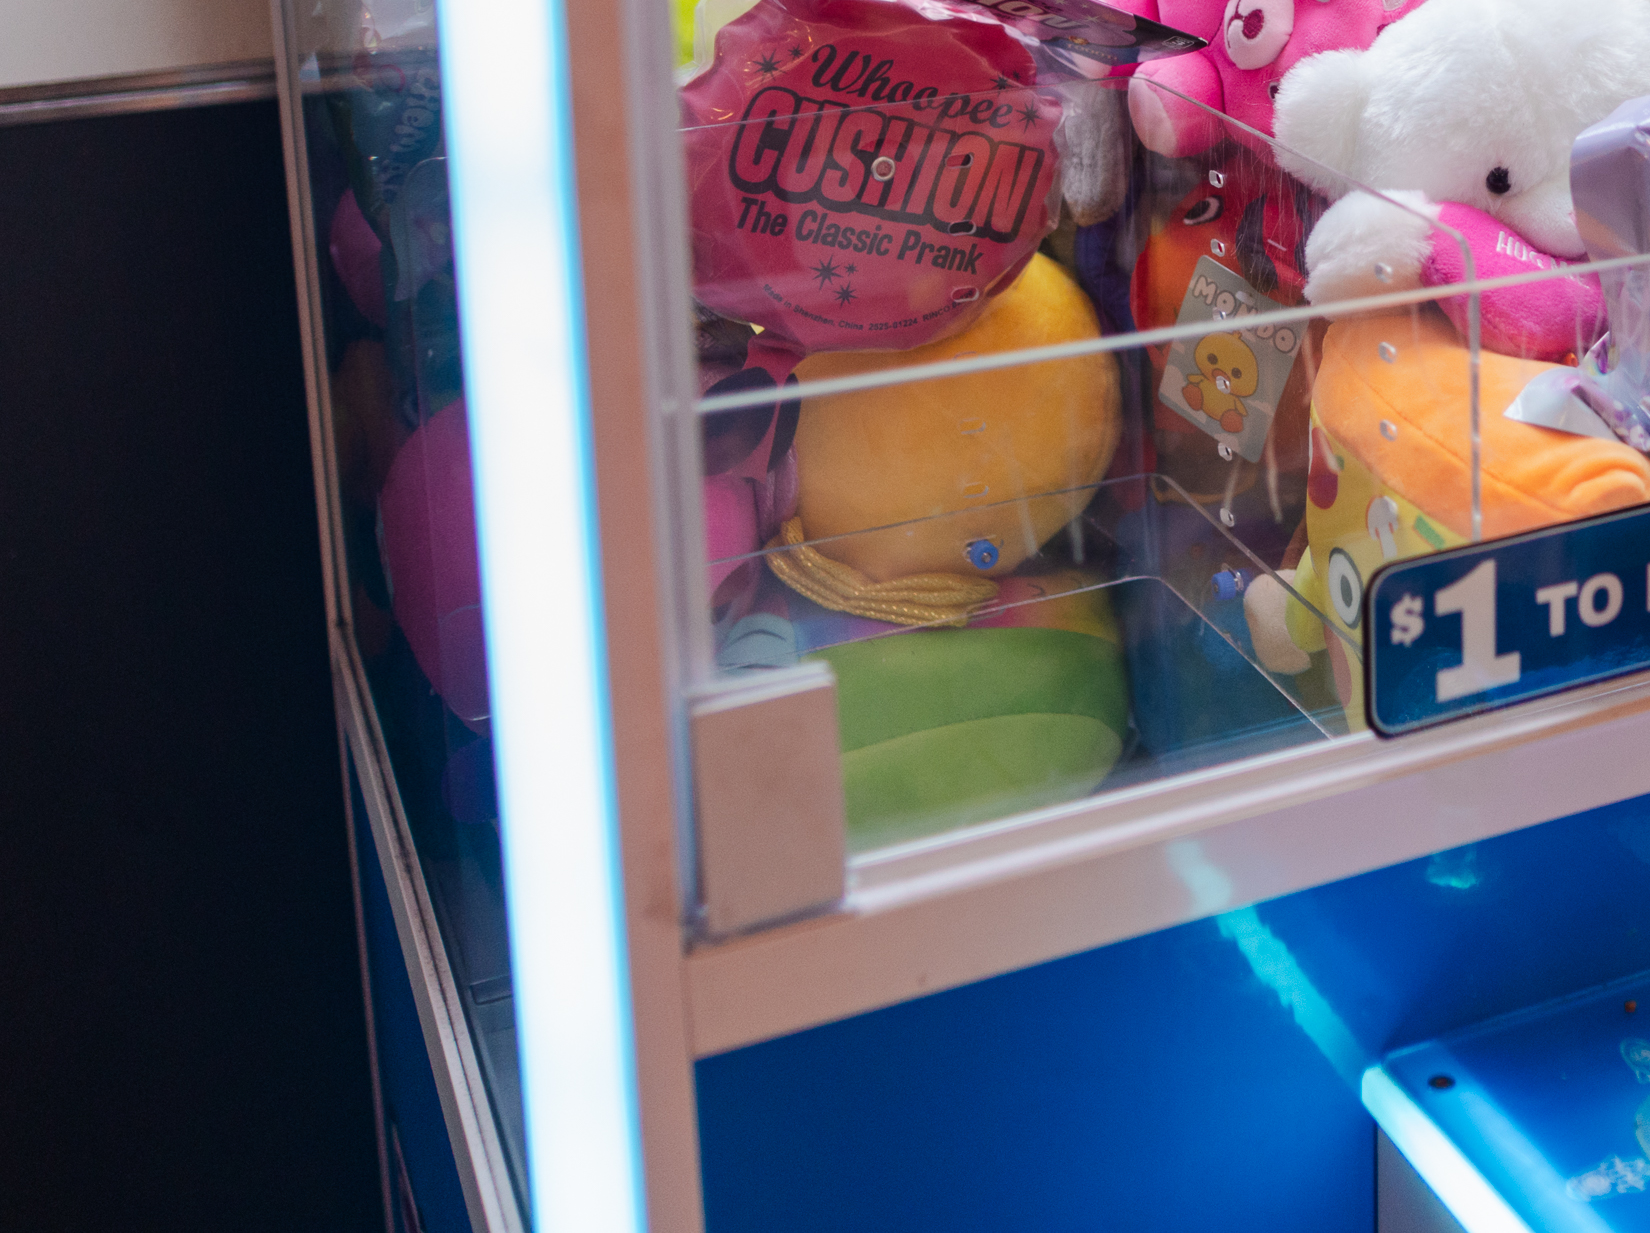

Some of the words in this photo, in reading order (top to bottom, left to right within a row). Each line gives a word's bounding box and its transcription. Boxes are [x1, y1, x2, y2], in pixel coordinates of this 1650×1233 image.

[811, 44, 1014, 130] Whoopee
[728, 86, 1046, 244] CUSHION
[736, 196, 788, 237] The
[795, 209, 893, 256] Classic
[897, 230, 984, 275] Prank
[1496, 231, 1544, 269] HUG
[762, 283, 783, 304] Made
[783, 300, 792, 309] in
[792, 304, 836, 327] Shenzhen,
[838, 319, 864, 331] China
[1390, 558, 1521, 703] $1
[1535, 572, 1623, 637] TO
